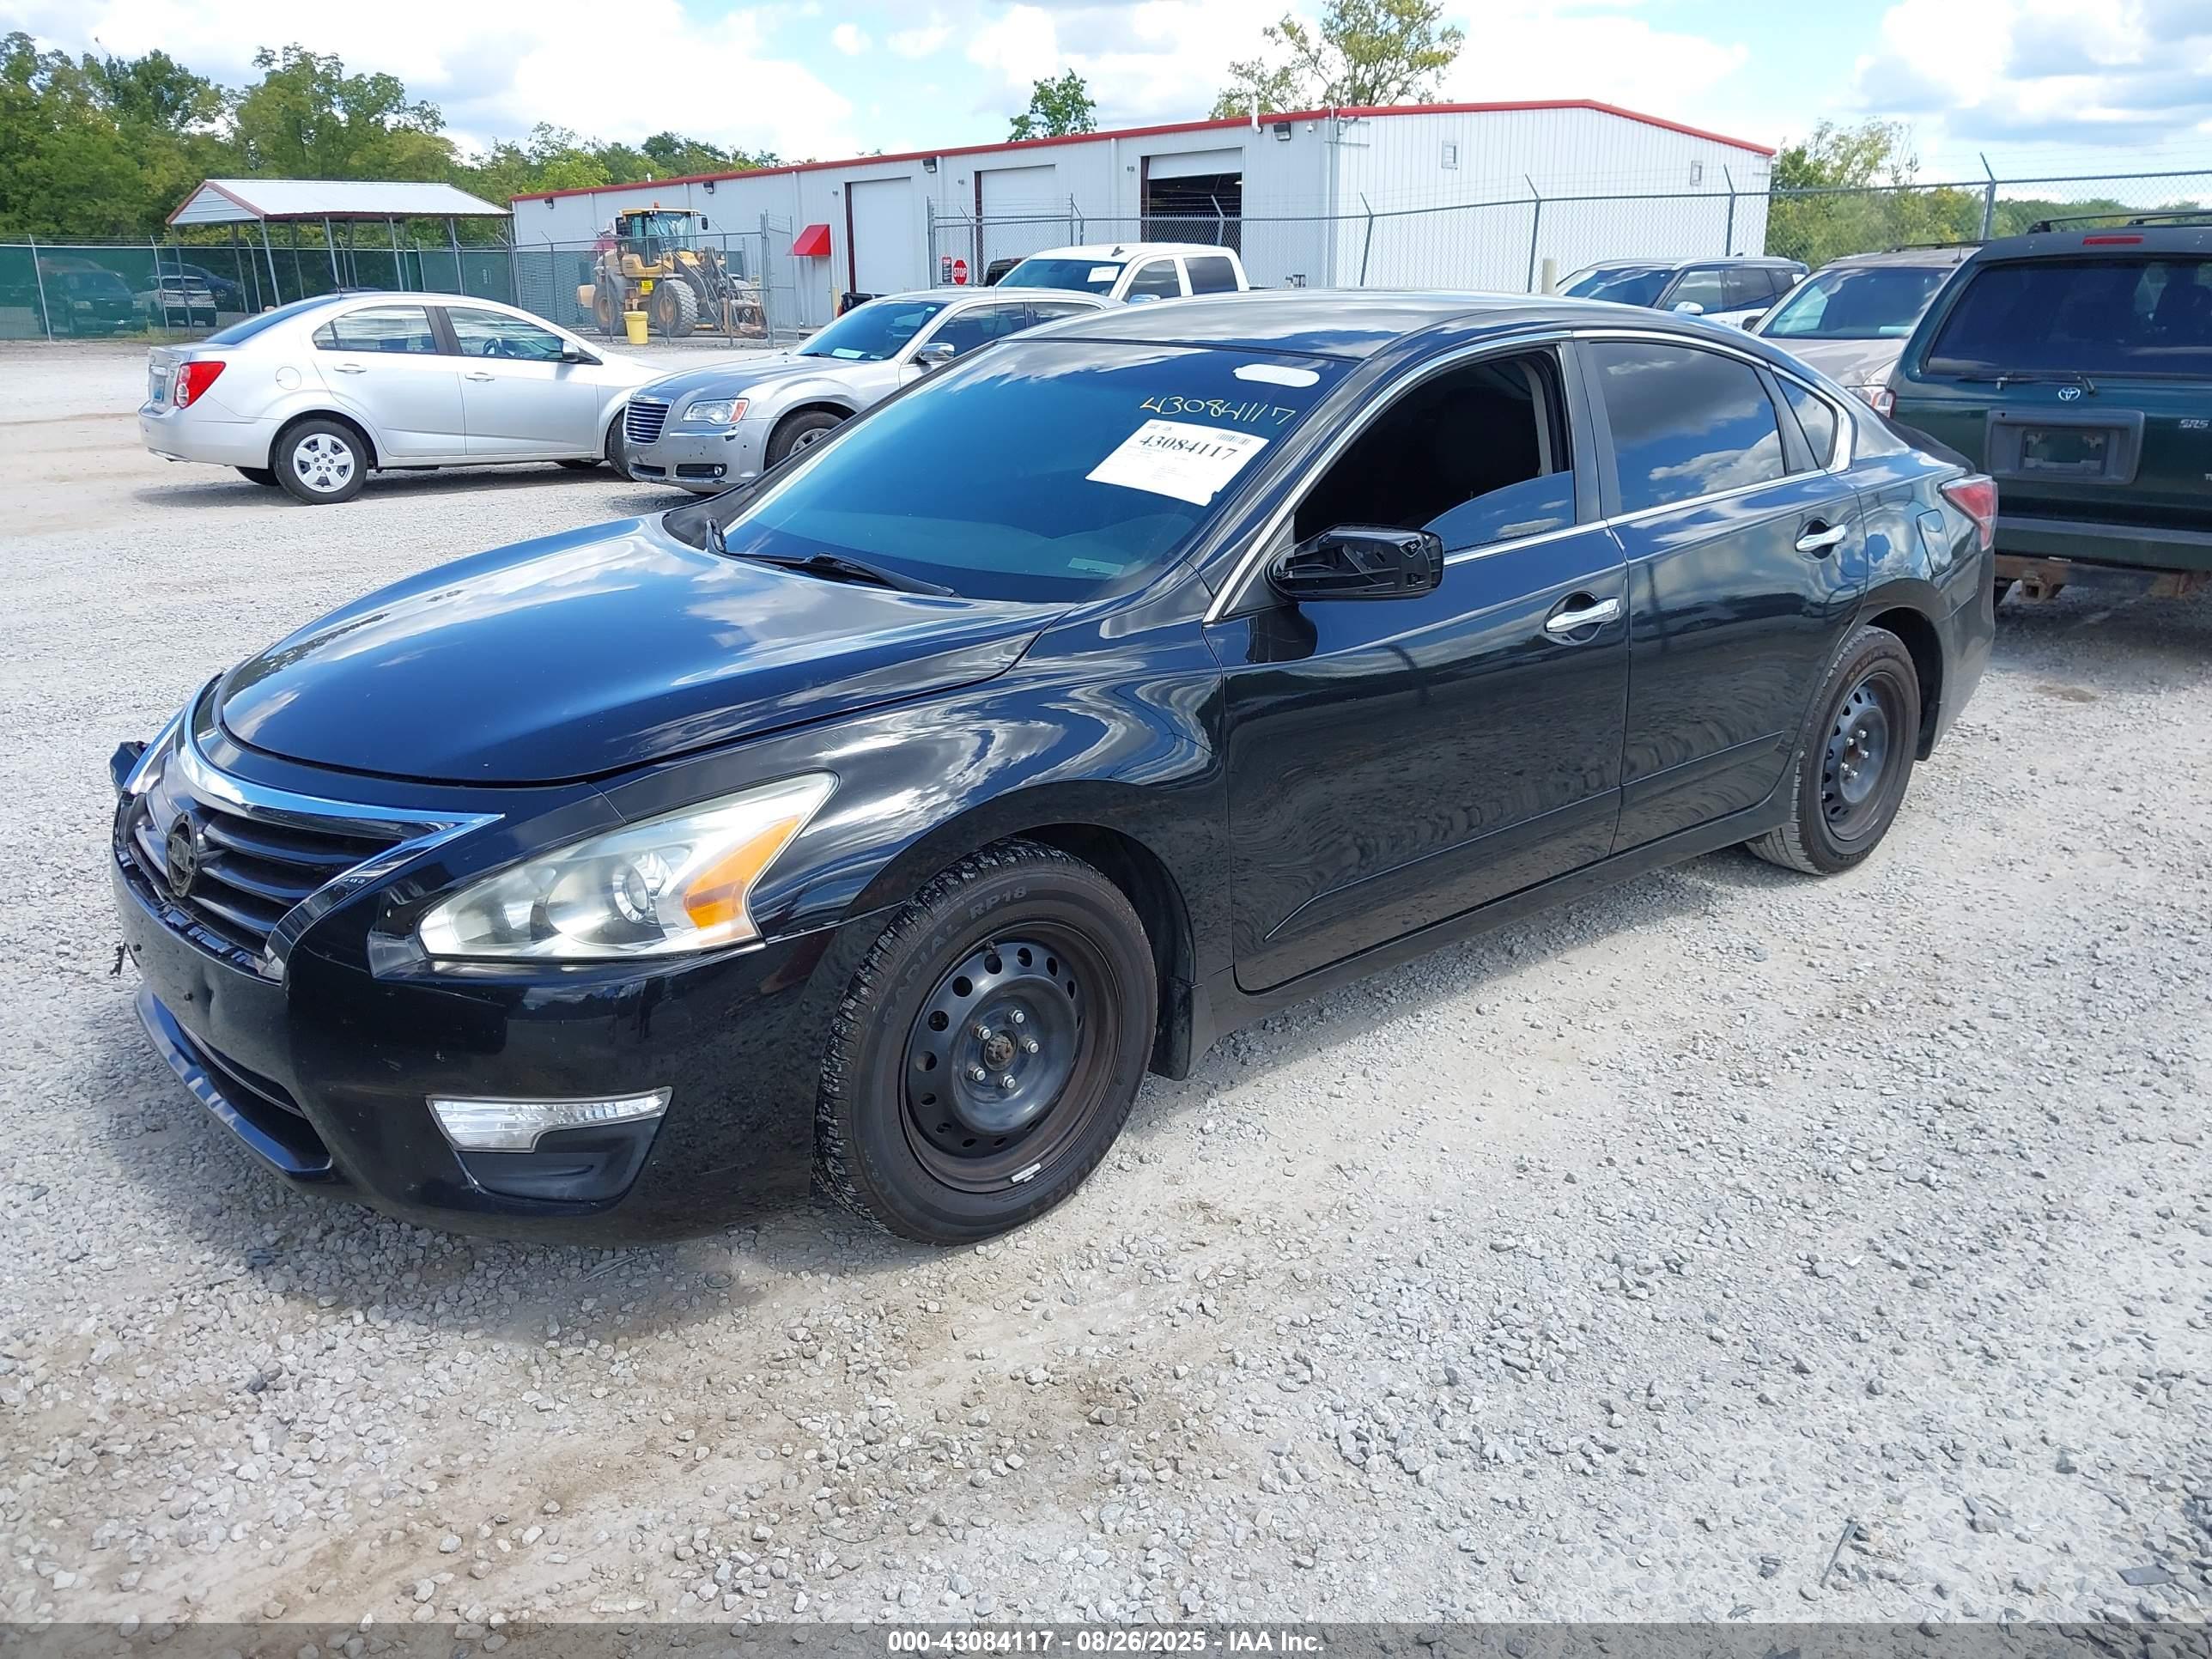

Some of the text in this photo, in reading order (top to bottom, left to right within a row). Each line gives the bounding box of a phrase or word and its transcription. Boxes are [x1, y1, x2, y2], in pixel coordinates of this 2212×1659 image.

[953, 267, 967, 278] STOP
[1139, 396, 1297, 426] 43084117
[1139, 434, 1239, 461] 43084117
[883, 885, 1028, 1024] RADIAL RP18
